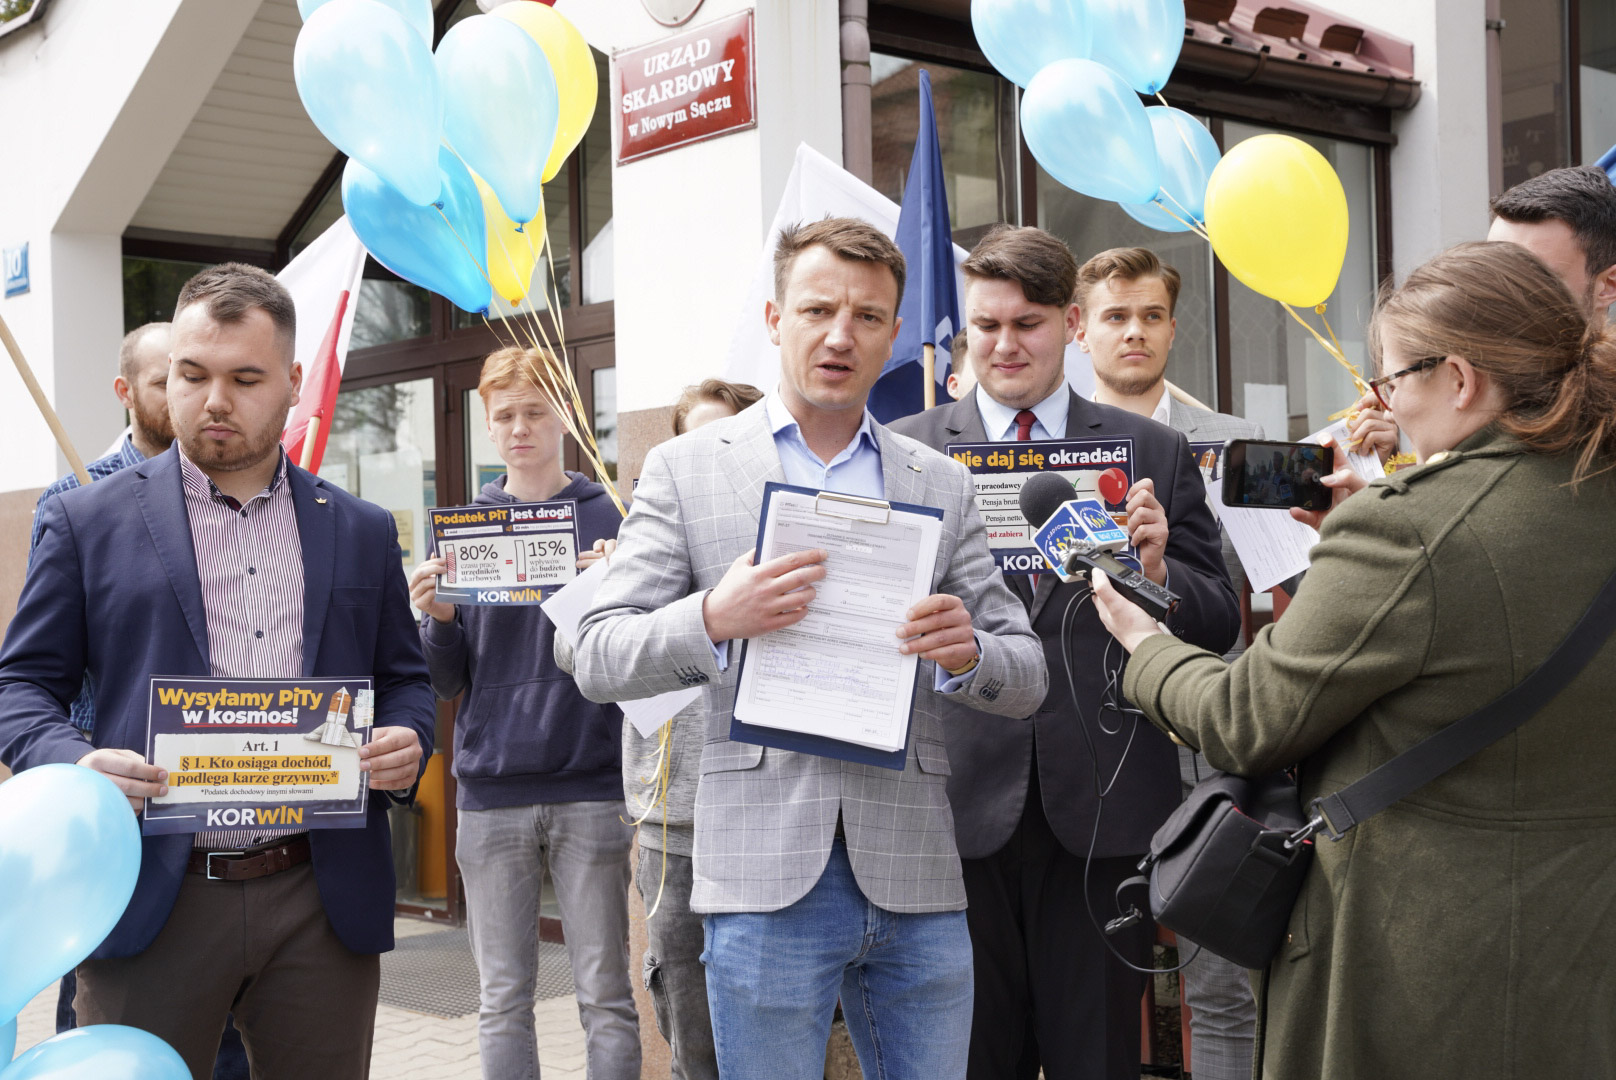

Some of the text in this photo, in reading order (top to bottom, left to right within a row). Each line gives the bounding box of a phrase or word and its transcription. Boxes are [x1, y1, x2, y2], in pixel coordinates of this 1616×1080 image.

[643, 38, 711, 77] URZĄD
[622, 59, 735, 114] SKARBOWY
[628, 95, 732, 137] w Nowym Sączu
[953, 447, 1128, 470] Nie daj się okradać!
[981, 482, 1022, 491] pracodawcy
[982, 498, 1002, 507] Pensja
[434, 505, 573, 525] Podatek PiT jest drogi!
[985, 515, 1006, 523] Pensja
[459, 544, 499, 561] 80%
[528, 539, 567, 557] 15%
[479, 561, 497, 569] pracy
[529, 558, 560, 566] wpływów
[539, 564, 566, 572] budżetu
[1003, 554, 1052, 571] KOR
[461, 567, 500, 576] urzędników
[461, 574, 502, 582] skarbowych
[530, 572, 558, 580] państwa
[157, 687, 324, 710] Wysyłamy PiTy
[182, 707, 299, 724] w kosmos!
[242, 741, 279, 752] Art. 1
[182, 756, 332, 771] § 1. Kto osiąga dochód,
[177, 772, 229, 787] podlega
[232, 772, 270, 783] karze
[229, 788, 265, 797] dochodowy
[266, 788, 288, 796] innymi
[288, 787, 314, 795] słowami
[206, 805, 304, 827] KORWIN
